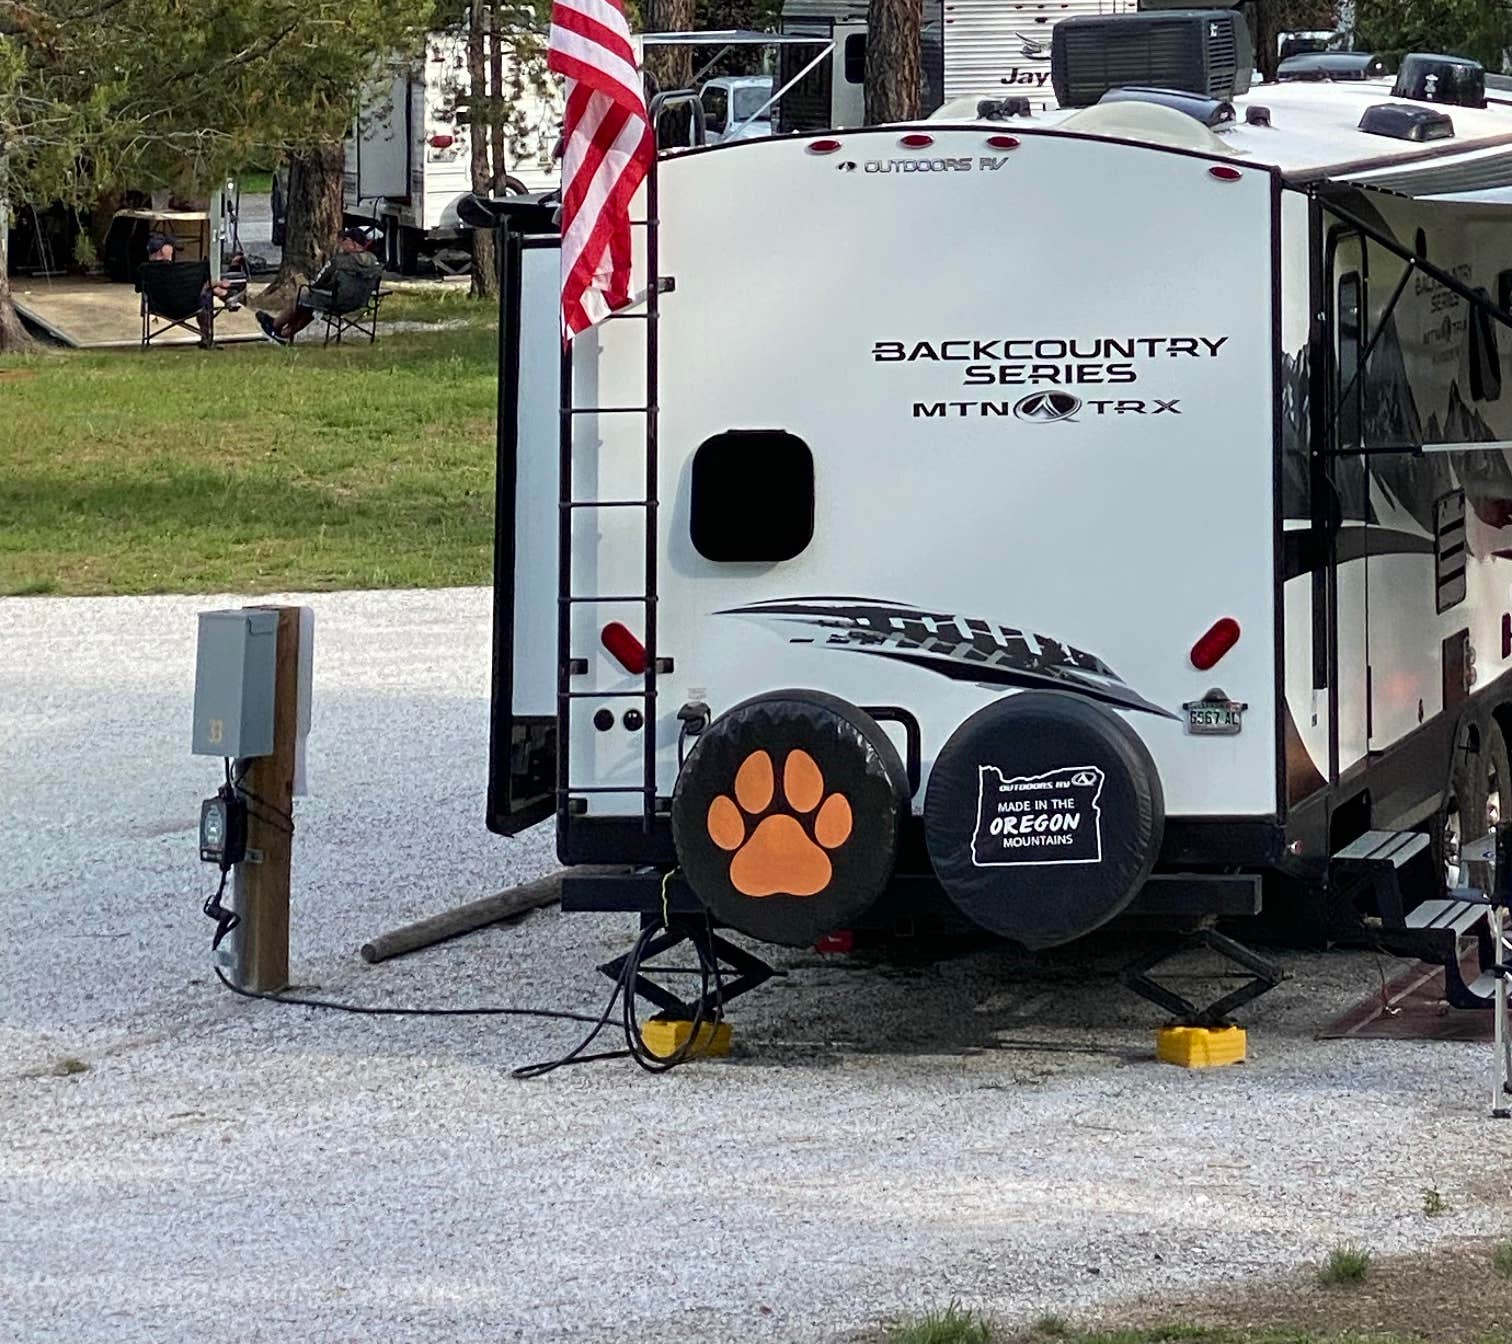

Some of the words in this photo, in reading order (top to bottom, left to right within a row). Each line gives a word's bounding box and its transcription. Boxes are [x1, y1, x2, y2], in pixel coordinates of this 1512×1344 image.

[1000, 67, 1051, 87] Jay
[864, 158, 973, 173] OUTDOORS
[979, 157, 1009, 172] RV
[872, 336, 1229, 362] BACKCOUNTRY
[963, 363, 1138, 385] SERIES
[913, 401, 1009, 418] MTN
[1087, 399, 1183, 415] TRX
[999, 781, 1053, 792] OUTDOORS
[1055, 780, 1072, 789] RV
[998, 800, 1031, 812] MADE
[1034, 799, 1048, 810] IN
[1051, 798, 1075, 810] THE
[990, 812, 1080, 836] OREGON
[1003, 834, 1074, 848] MOUNTAINS
